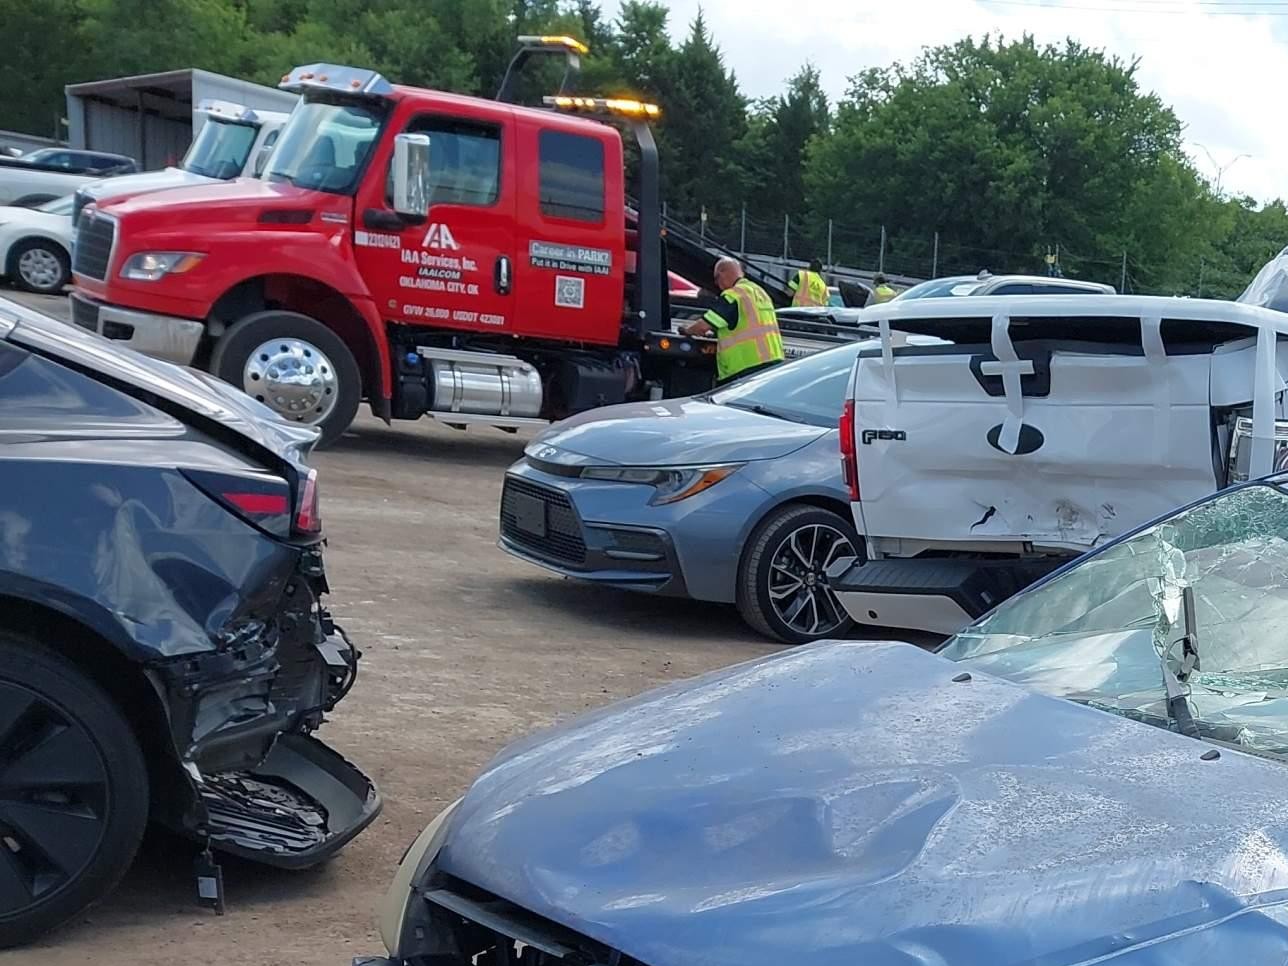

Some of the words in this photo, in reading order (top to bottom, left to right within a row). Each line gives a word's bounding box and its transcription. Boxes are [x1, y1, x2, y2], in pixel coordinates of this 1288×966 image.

[401, 249, 419, 264] IAA
[421, 253, 461, 270] Services,
[462, 256, 478, 271] Inc.
[532, 242, 564, 257] Career
[567, 247, 576, 258] in
[578, 248, 609, 262] PARK?
[531, 257, 544, 267] Put
[544, 259, 551, 267] it
[551, 260, 559, 269] in
[559, 261, 577, 271] Drive
[578, 264, 593, 273] with
[399, 275, 446, 292] OKLAHOMA
[467, 284, 479, 295] OK
[403, 304, 424, 317] GVW
[453, 310, 479, 322] USDOT
